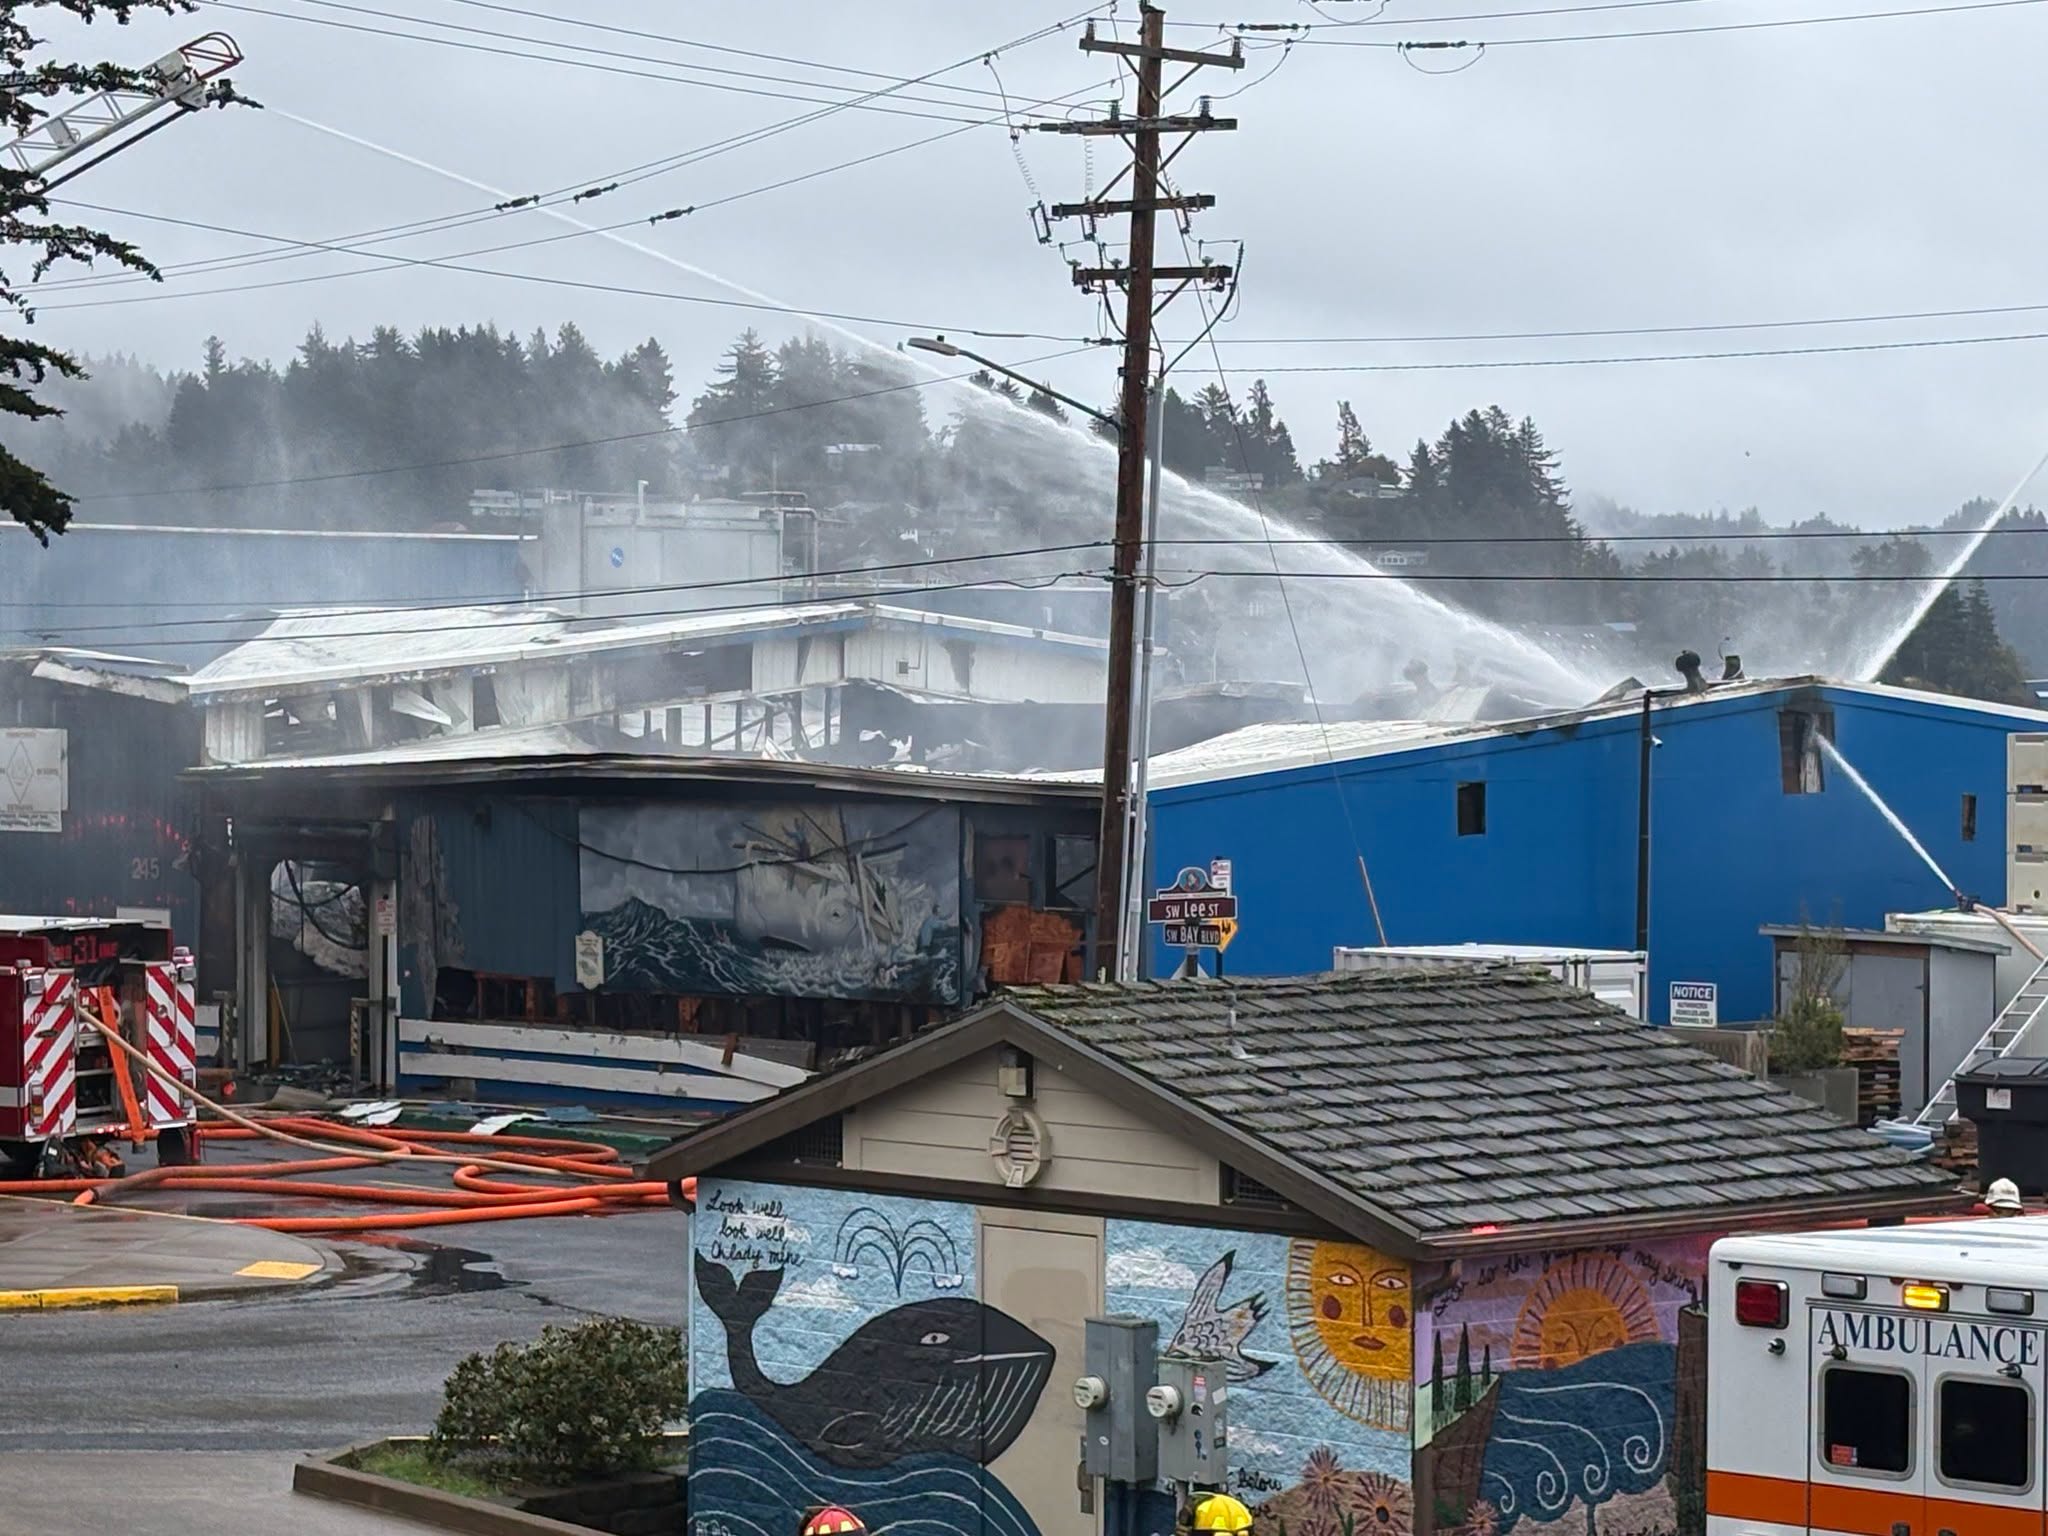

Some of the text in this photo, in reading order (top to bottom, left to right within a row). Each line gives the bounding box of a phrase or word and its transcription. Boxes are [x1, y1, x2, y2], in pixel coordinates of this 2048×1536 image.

[131, 857, 160, 879] 245
[1165, 901, 1219, 918] SW Lee ST
[1166, 926, 1219, 943] SW BAY BLVD
[74, 935, 97, 964] 31
[1673, 985, 1712, 999] NOTICE
[706, 1189, 747, 1214] Look
[1633, 1250, 1662, 1286] may
[1817, 1310, 2039, 1366] AMBULANCE
